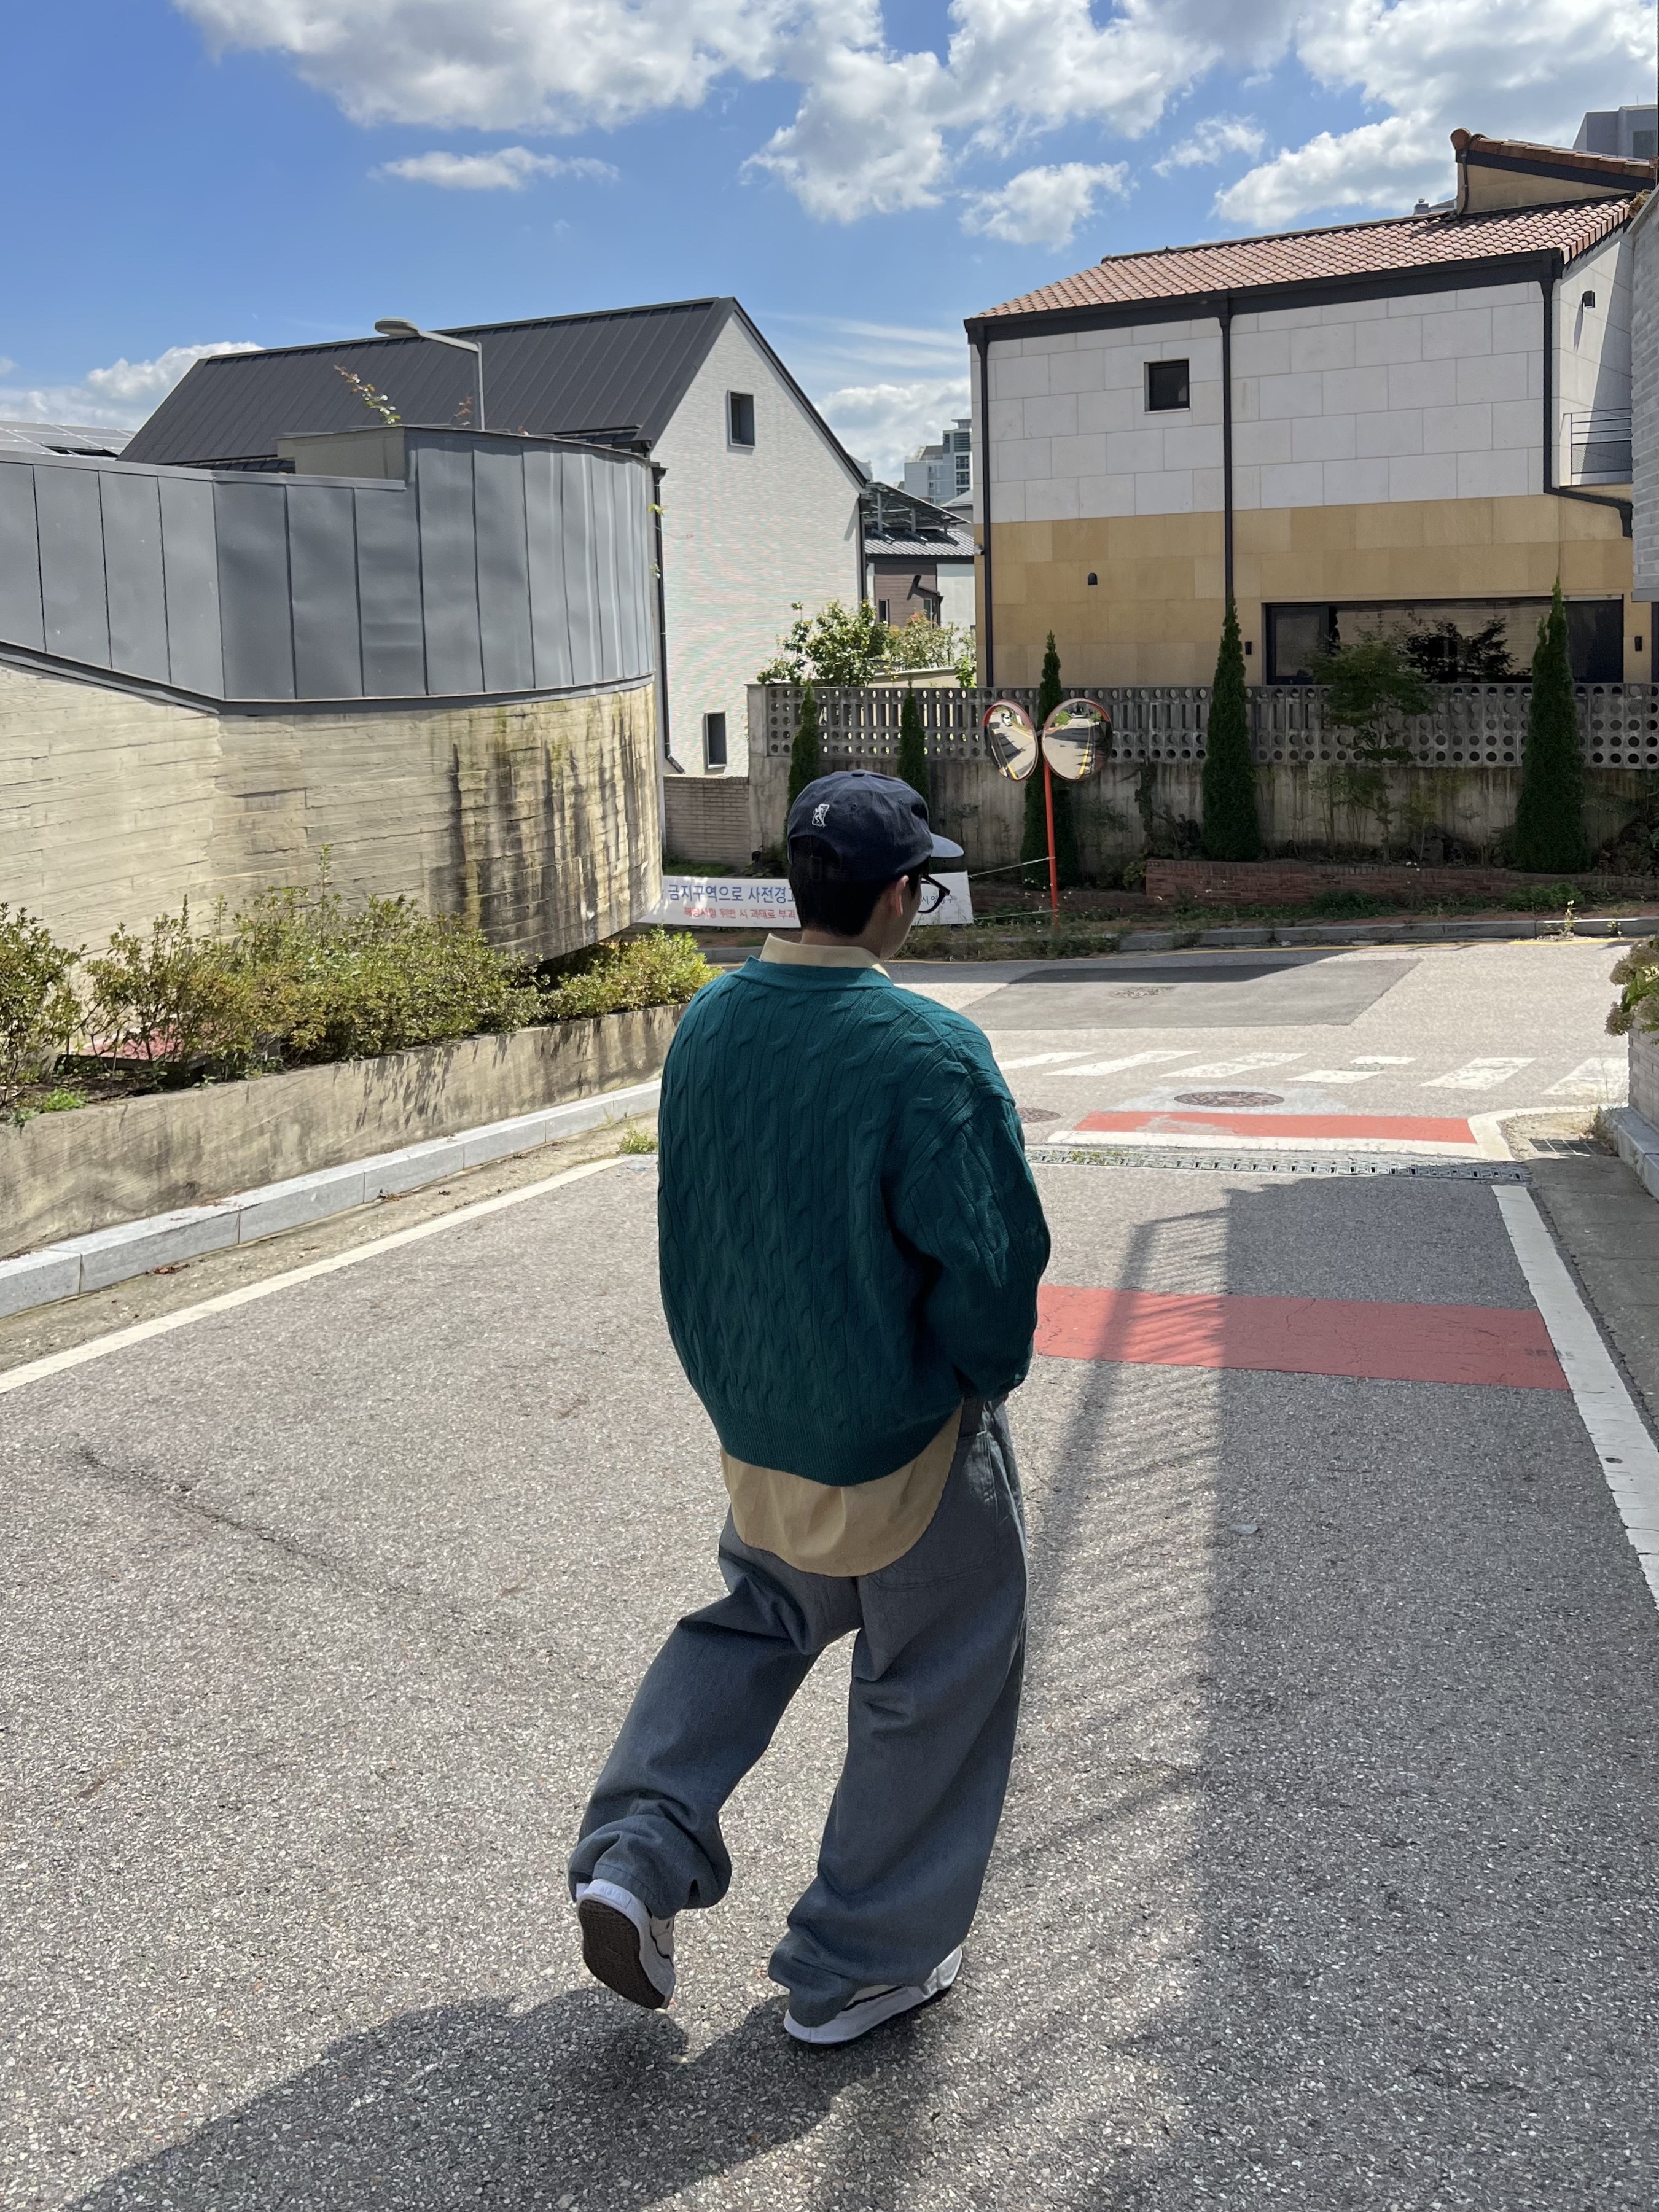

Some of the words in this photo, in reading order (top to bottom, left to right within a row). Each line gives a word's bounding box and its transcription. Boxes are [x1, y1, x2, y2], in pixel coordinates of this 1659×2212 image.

[668, 884, 743, 902] 금지구역으로
[684, 907, 717, 919] 해당사항
[720, 908, 736, 919] 위반
[740, 909, 748, 919] 시
[750, 909, 776, 919] 과태료
[778, 909, 797, 919] 부과
